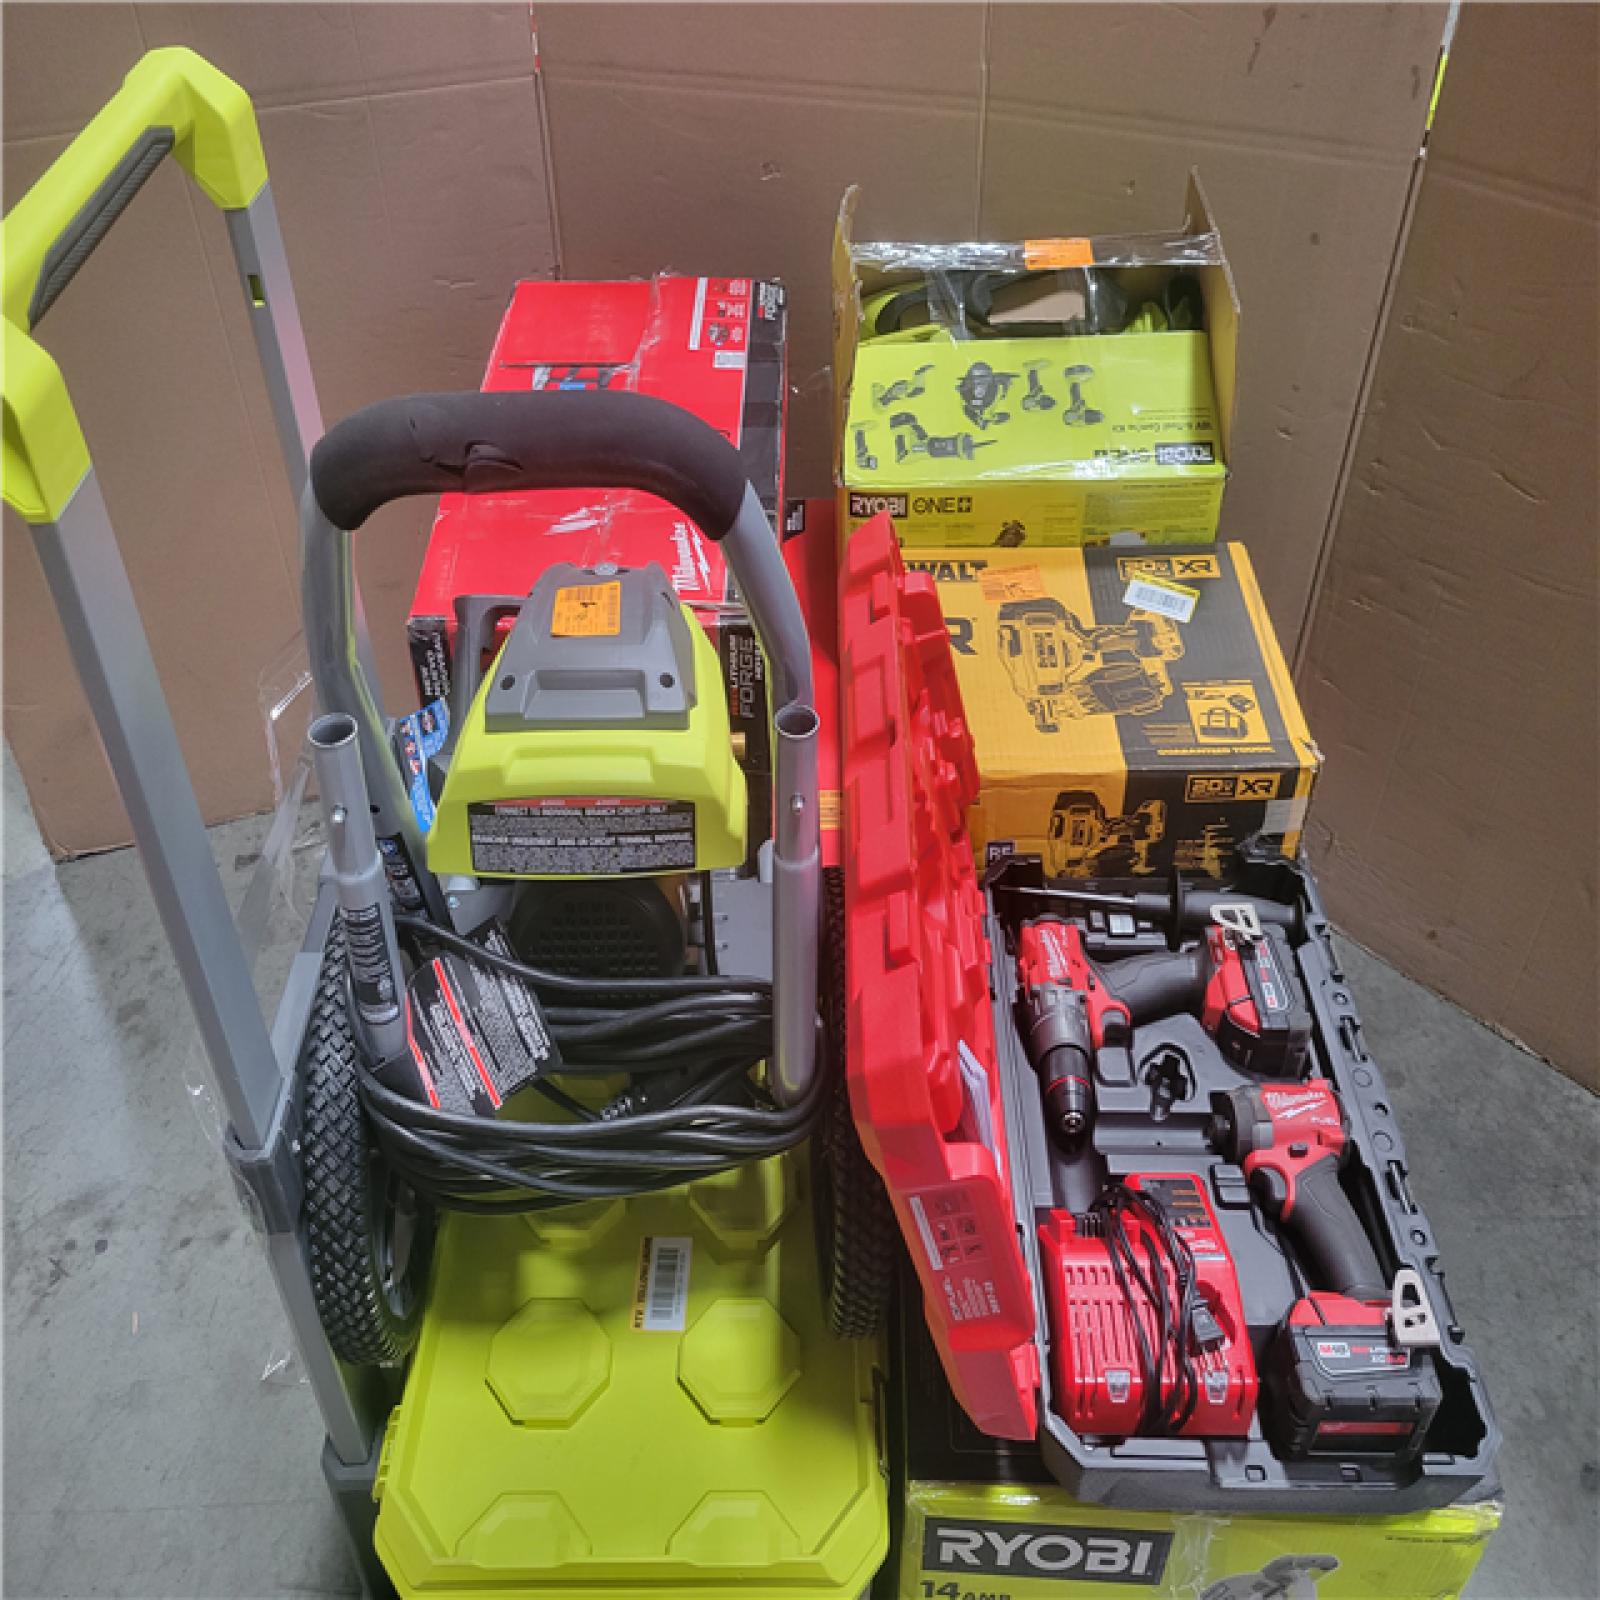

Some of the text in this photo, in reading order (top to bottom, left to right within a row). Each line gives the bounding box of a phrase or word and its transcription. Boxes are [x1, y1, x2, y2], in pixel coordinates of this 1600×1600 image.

[851, 495, 906, 514] RYOBI
[740, 636, 755, 718] FORGE
[936, 1527, 1153, 1576] RYOBI
[919, 1580, 961, 1599] 14
